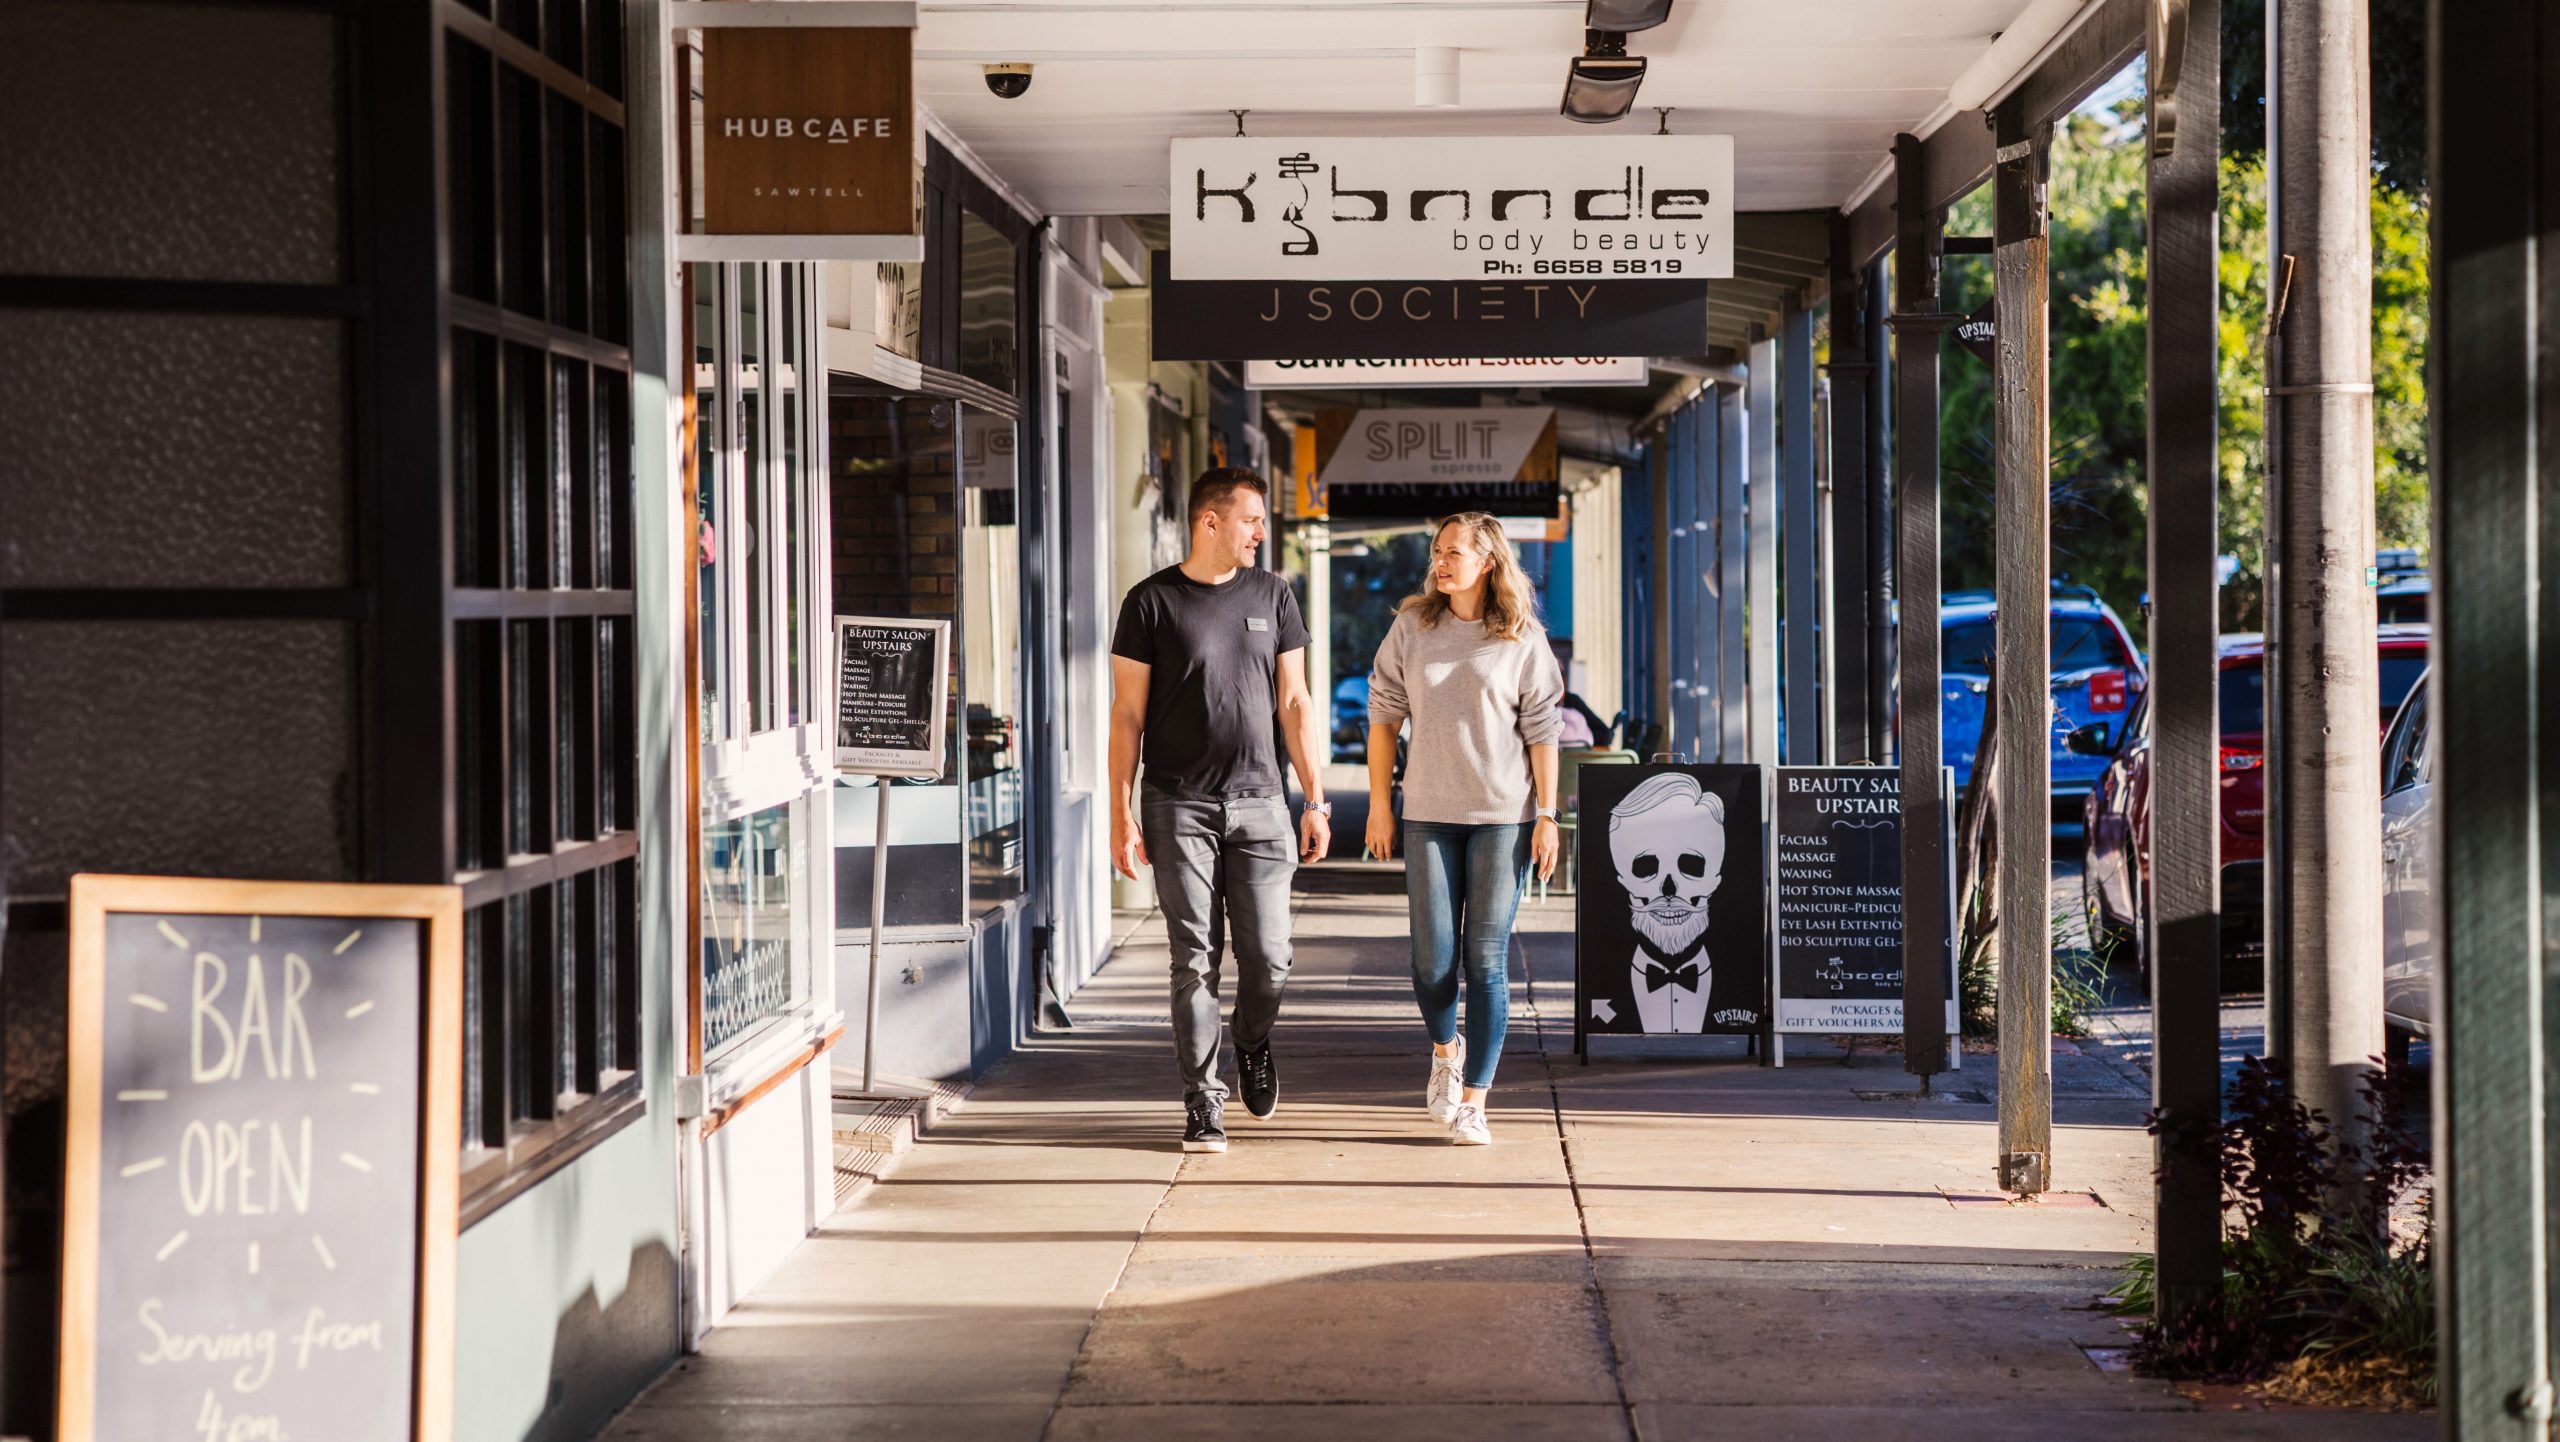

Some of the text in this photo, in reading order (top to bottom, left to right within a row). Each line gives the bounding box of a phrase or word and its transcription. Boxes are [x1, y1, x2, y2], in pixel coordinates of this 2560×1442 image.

[754, 187, 863, 197] SAWTELL
[1453, 229, 1709, 255] body beauty
[1484, 260, 1682, 274] Ph: 6658 5819
[1958, 322, 1996, 339] UPSTAI
[1366, 420, 1500, 462] SPLIT
[1431, 463, 1502, 475] espresso
[849, 629, 927, 641] BEAUTY SALON
[863, 641, 912, 651] UPSTAIRS
[1788, 777, 1901, 793] BEAUTY SAL
[1816, 798, 1901, 814] UPSTAIR
[1779, 834, 1828, 845] FACIALS
[1780, 852, 1836, 863] MASSAGE
[1780, 868, 1832, 879] WAXING
[1781, 885, 1902, 896] HOT STONE MASSA
[1781, 919, 1902, 930] EYE LASH EXTENTIO
[1781, 936, 1802, 947] BIO
[1805, 936, 1872, 947] SCULPTURE
[1831, 1005, 1891, 1015] PACKAGES
[191, 951, 317, 1084] BAR
[1713, 1009, 1758, 1024] UPSTAIRS
[1786, 1018, 1817, 1028] GIFT
[1818, 1018, 1884, 1028] VOUCHERS
[178, 1115, 314, 1217] OPEN
[137, 1297, 382, 1393] Serving from
